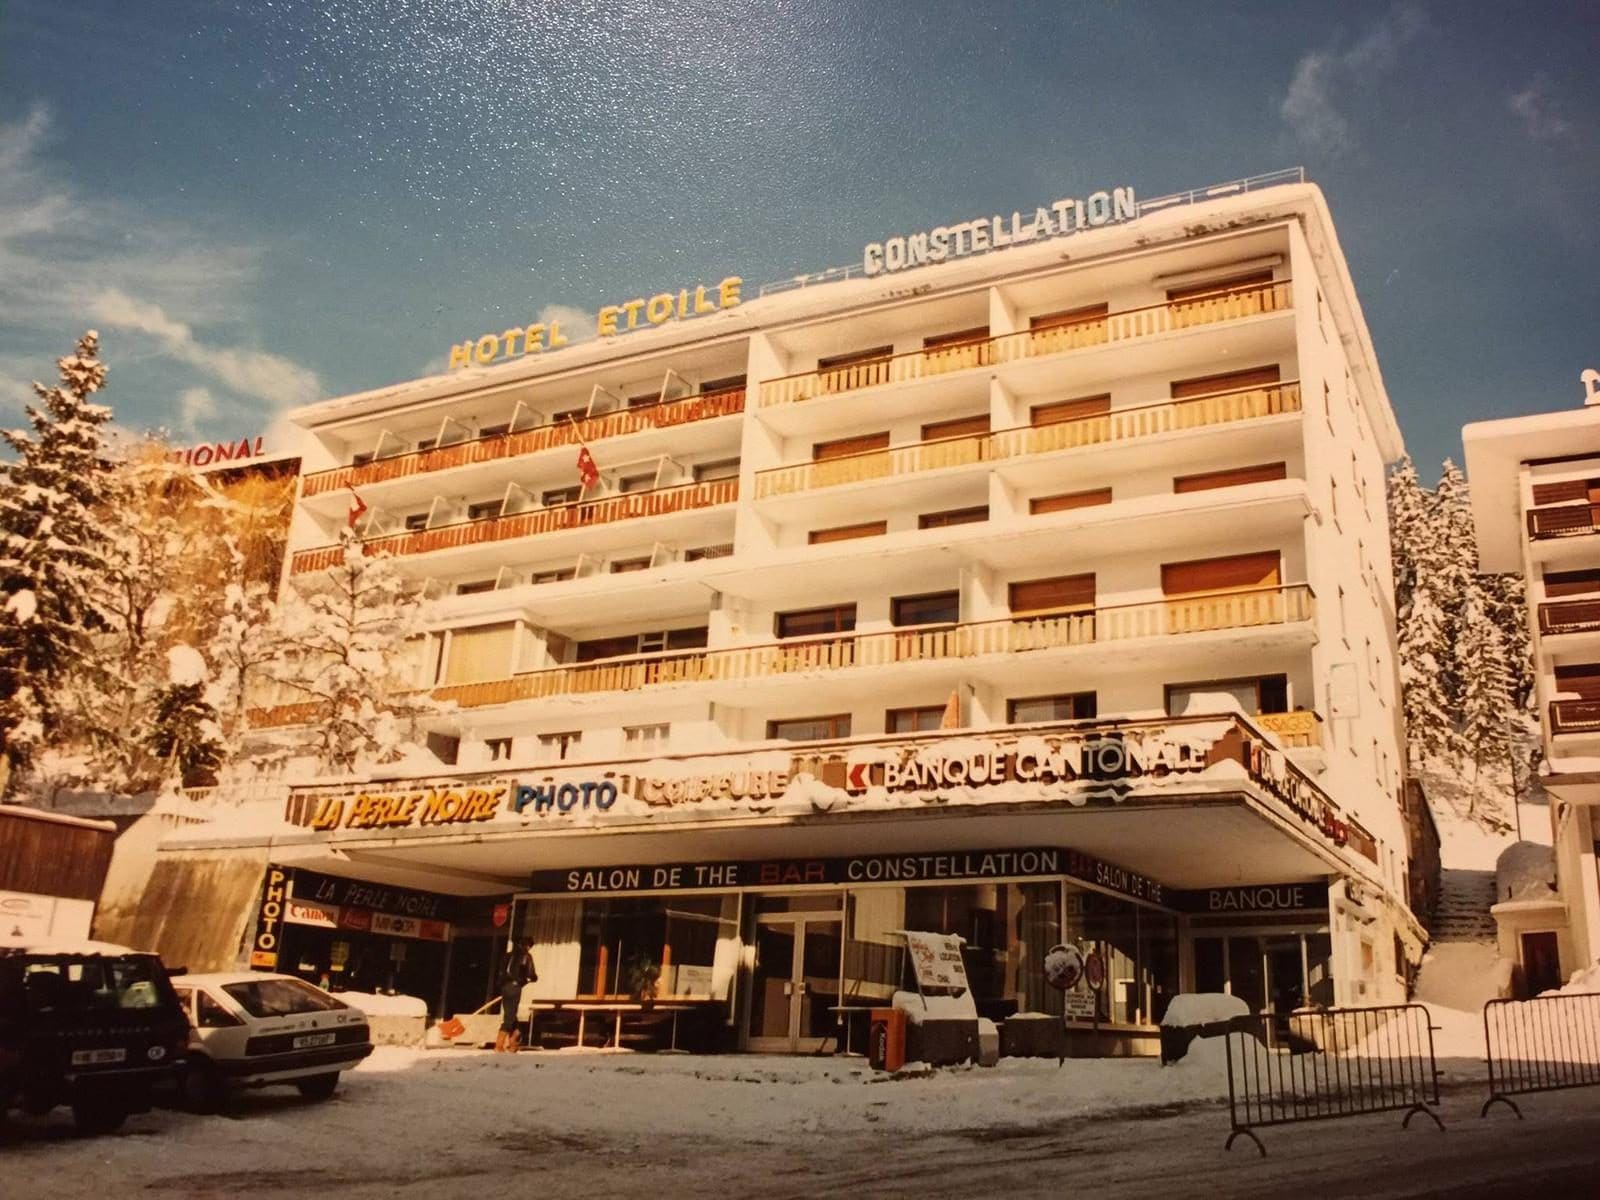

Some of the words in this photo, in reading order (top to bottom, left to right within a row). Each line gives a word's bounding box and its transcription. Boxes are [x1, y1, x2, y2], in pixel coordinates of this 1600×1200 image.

[863, 186, 1136, 276] CONSTELLATION
[449, 319, 569, 369] HOTEL
[597, 279, 743, 337] ETOILE
[883, 751, 1007, 788] BANQUE
[1013, 735, 1206, 781] CANTONALE
[312, 798, 345, 831] LA
[345, 793, 424, 828] PERLE
[420, 787, 506, 825] NOIRE
[515, 773, 618, 813] PHOTO
[567, 868, 640, 891] SALON
[653, 867, 682, 888] DE
[695, 865, 738, 885] THE
[759, 861, 826, 884] BAR
[846, 851, 1059, 881] CONSTELLATION
[1096, 863, 1129, 889] SALON
[1131, 874, 1143, 897] DE
[258, 870, 285, 950] PHOTO
[315, 879, 337, 899] LA
[343, 883, 389, 909] PERLE
[1208, 887, 1305, 911] BANQUE
